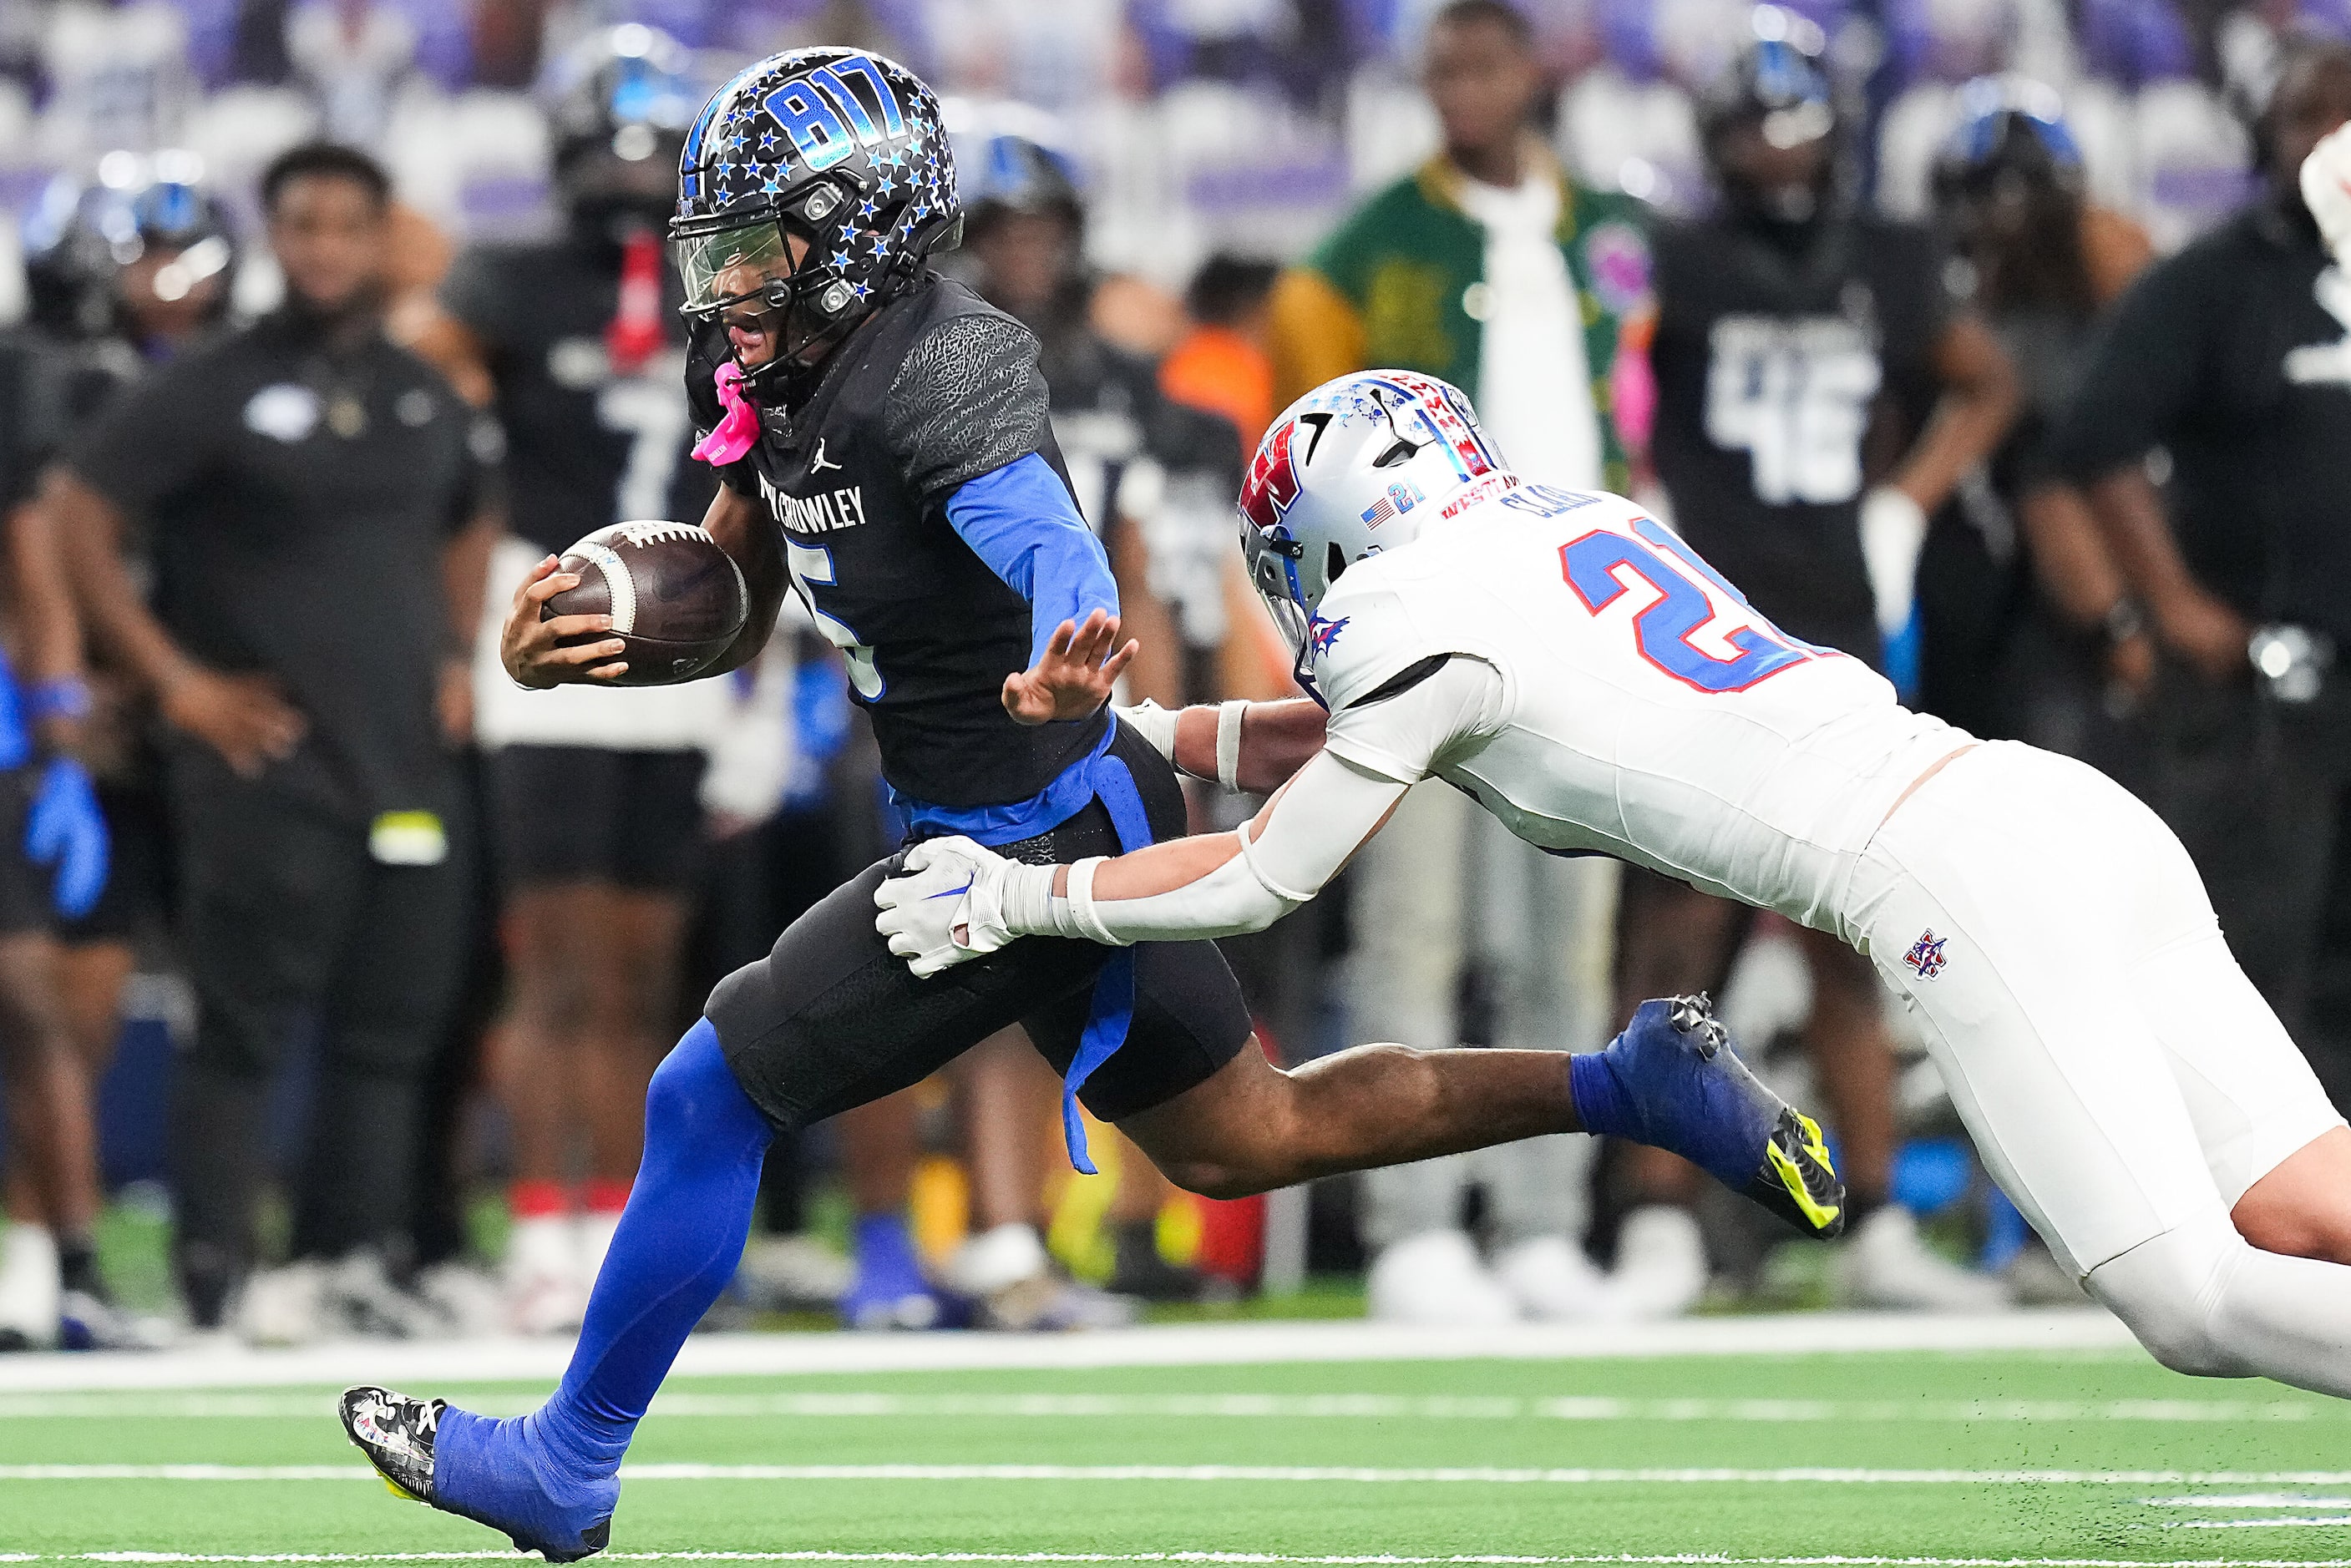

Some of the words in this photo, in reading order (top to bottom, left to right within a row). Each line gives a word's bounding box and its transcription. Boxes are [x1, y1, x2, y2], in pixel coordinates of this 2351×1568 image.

[763, 55, 908, 172] 817
[778, 486, 866, 534] CROWLEY
[1387, 475, 1426, 514] 21
[1558, 516, 1850, 694] 21
